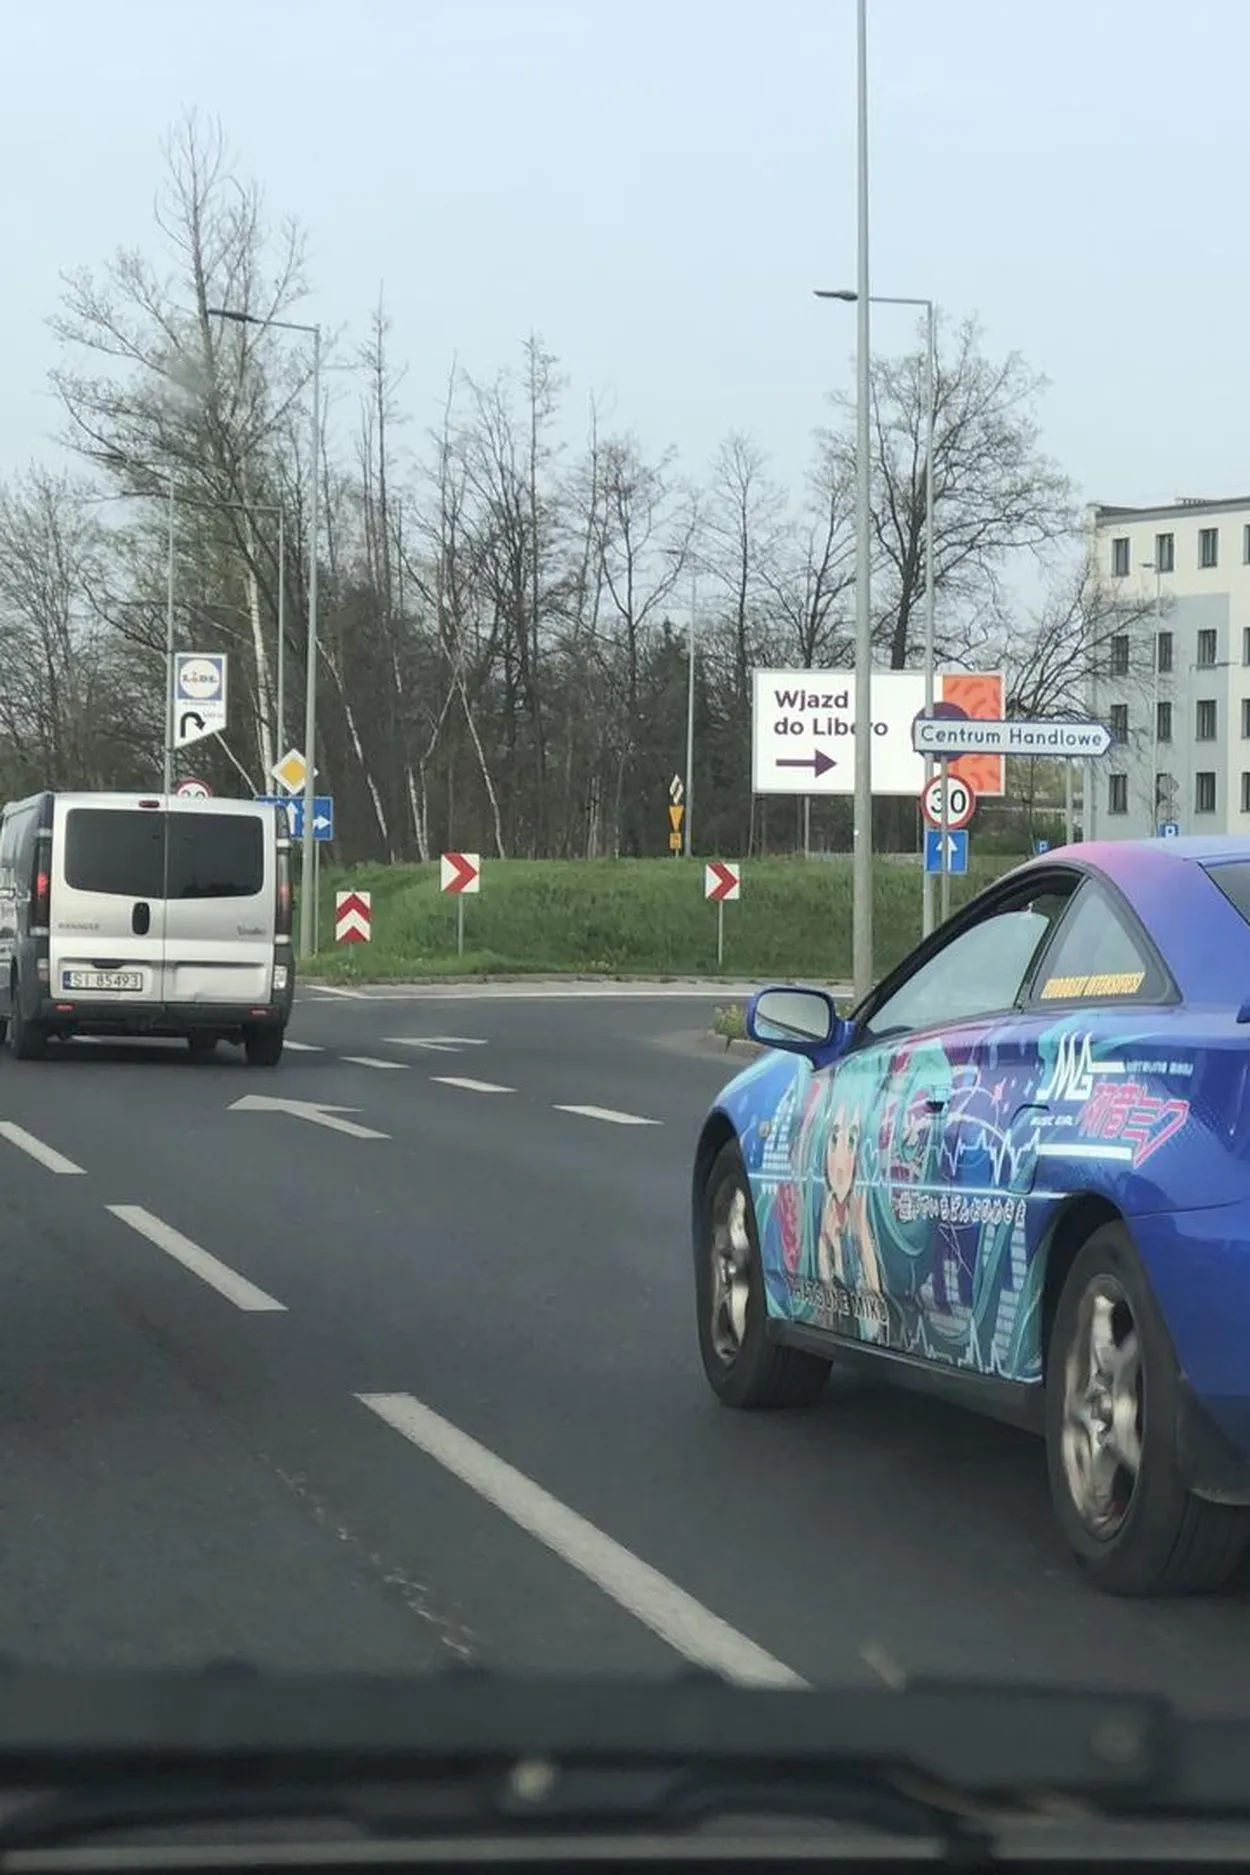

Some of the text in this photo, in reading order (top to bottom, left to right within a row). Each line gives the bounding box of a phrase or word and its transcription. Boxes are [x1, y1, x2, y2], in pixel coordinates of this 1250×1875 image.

[774, 690, 849, 711] Wjazd
[774, 717, 889, 736] do Libo
[921, 725, 1102, 746] Centrum Handlowe
[931, 789, 967, 813] 30
